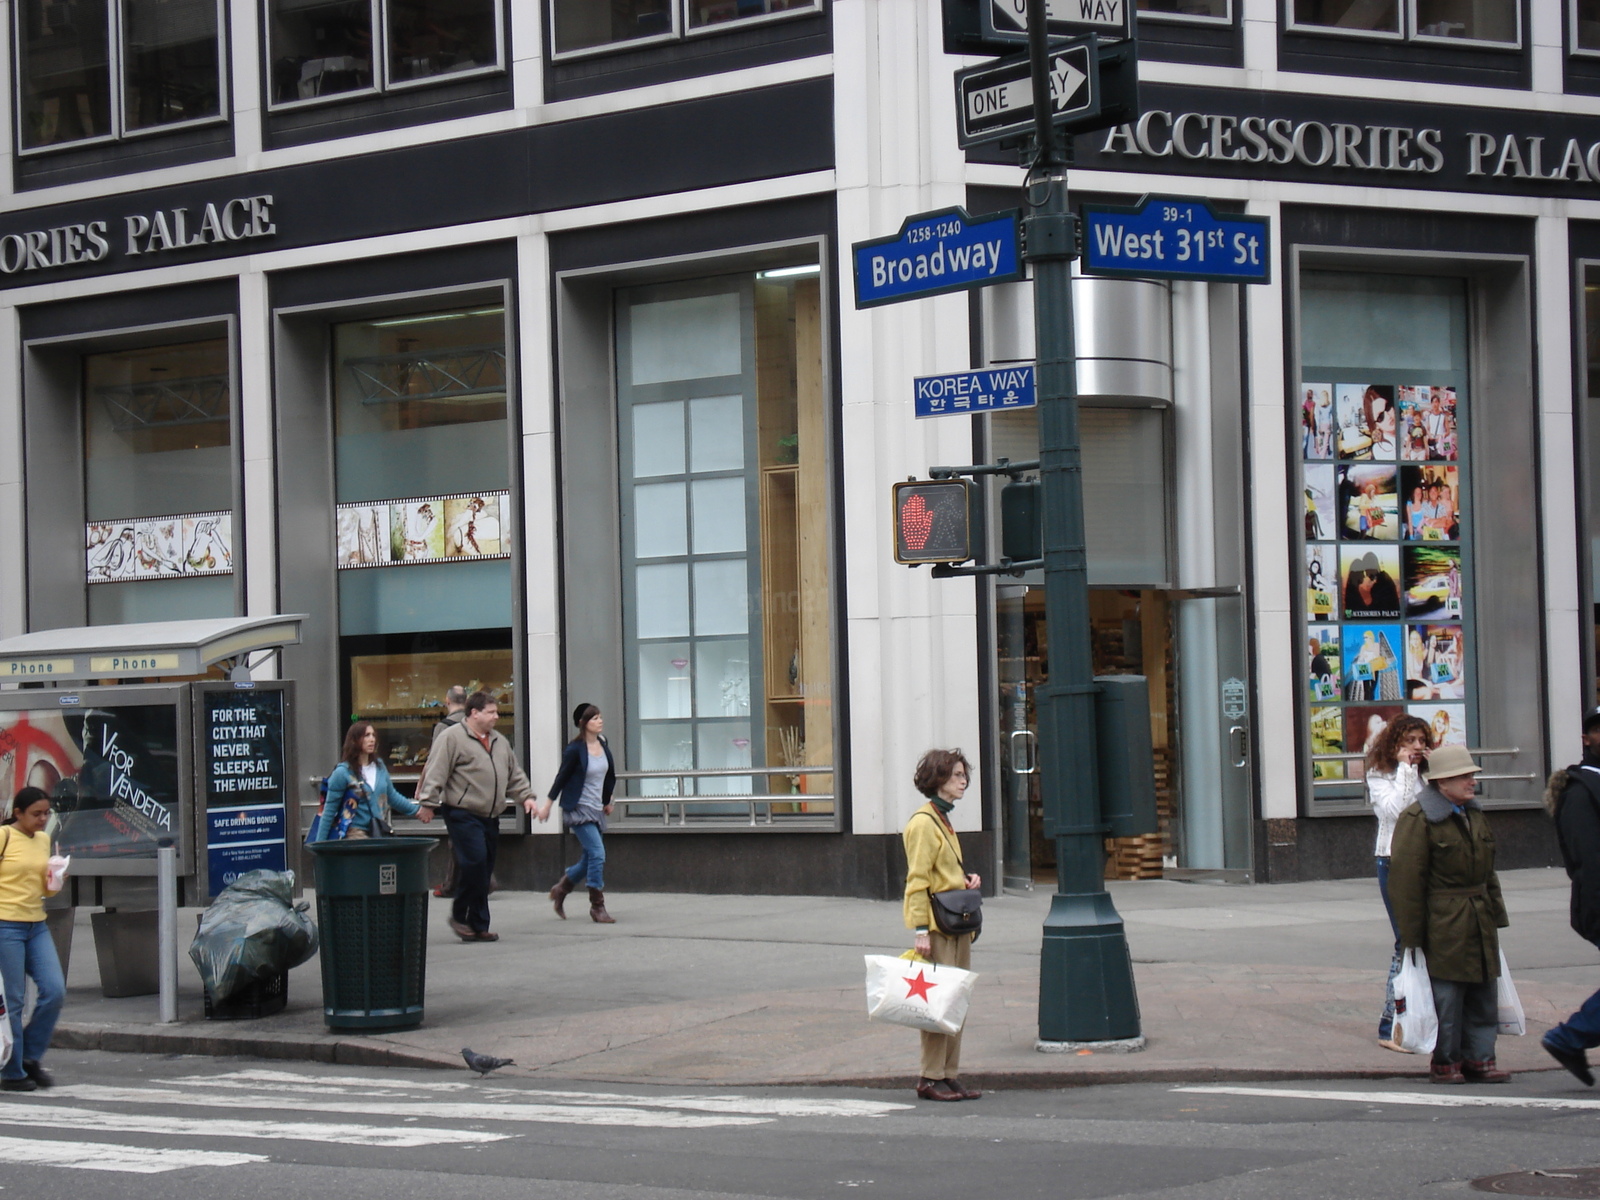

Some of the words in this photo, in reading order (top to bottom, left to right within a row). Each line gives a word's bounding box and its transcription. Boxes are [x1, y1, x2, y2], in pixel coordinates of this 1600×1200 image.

[1080, 0, 1118, 21] WAY
[974, 87, 1009, 115] ONE
[1050, 70, 1069, 96] AY
[1101, 110, 1444, 174] ACCESSORIES
[1163, 206, 1192, 222] 39-1
[0, 221, 109, 273] ORIES
[124, 194, 276, 255] PALACE
[906, 220, 961, 244] 1258-1240
[1094, 223, 1165, 260] West
[1176, 228, 1225, 262] 31st
[1233, 232, 1260, 265] St
[872, 239, 1002, 287] Broadway
[918, 375, 982, 399] KOREA
[989, 370, 1029, 391] WAY
[11, 661, 53, 674] Phone
[112, 657, 157, 671] Phone
[212, 708, 233, 722] FOR
[234, 707, 257, 721] THE
[102, 723, 118, 757] V
[212, 726, 238, 740] CITY
[238, 725, 267, 738] THAT
[108, 744, 134, 776] FOR
[213, 743, 250, 757] NEVER
[213, 760, 255, 775] SLEEPS
[256, 759, 270, 773] AT
[213, 778, 236, 792] THE
[237, 776, 278, 791] WHEEL.
[110, 764, 171, 832] VENDETTA
[214, 819, 230, 828] SAFE
[230, 816, 256, 826] DRIVING
[256, 815, 278, 825] BONUS
